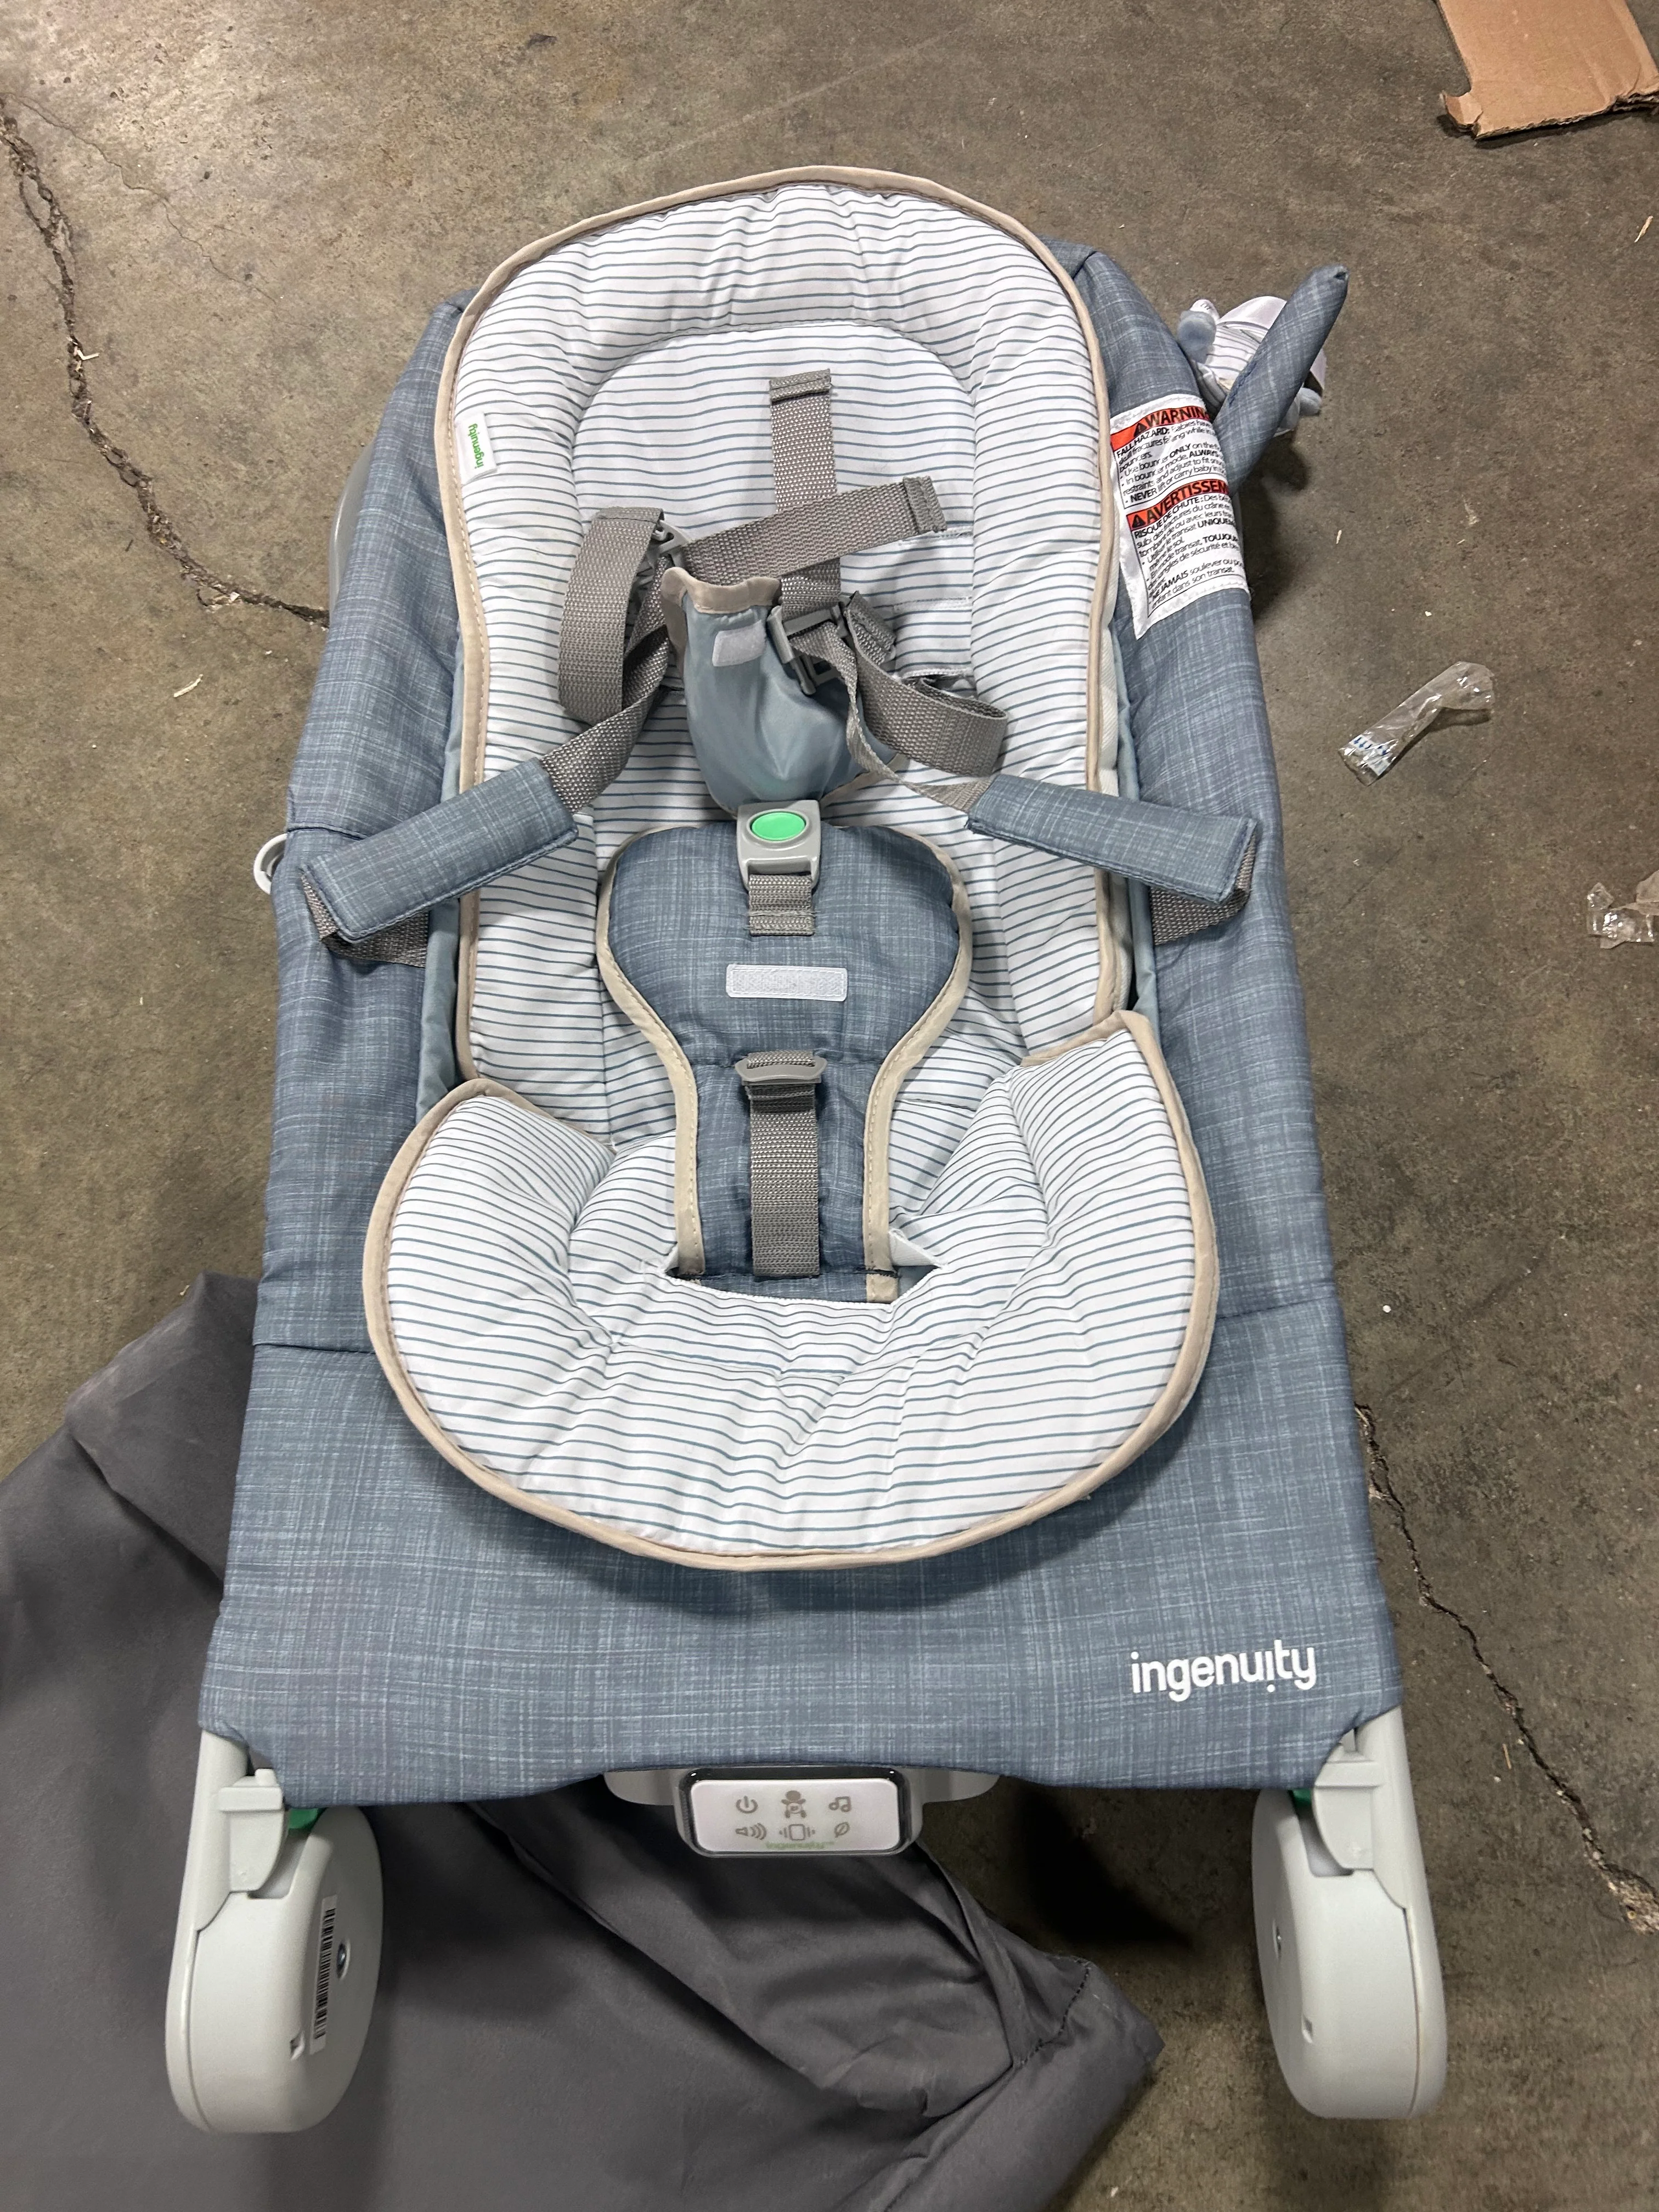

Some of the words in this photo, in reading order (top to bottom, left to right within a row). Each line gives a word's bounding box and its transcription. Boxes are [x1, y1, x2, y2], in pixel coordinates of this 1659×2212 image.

[1144, 407, 1210, 427] WARNIN
[468, 423, 485, 469] ingenuity
[1116, 443, 1134, 459] FALL
[1170, 443, 1191, 458] ONLY
[1156, 470, 1169, 483] and
[1130, 488, 1157, 503] NEVER
[1134, 520, 1164, 539] RISQUE
[1163, 511, 1172, 523] DE
[1175, 520, 1185, 528] ou
[1180, 553, 1190, 562] de
[1192, 574, 1206, 583] son
[1131, 1639, 1317, 1701] ingenuity
